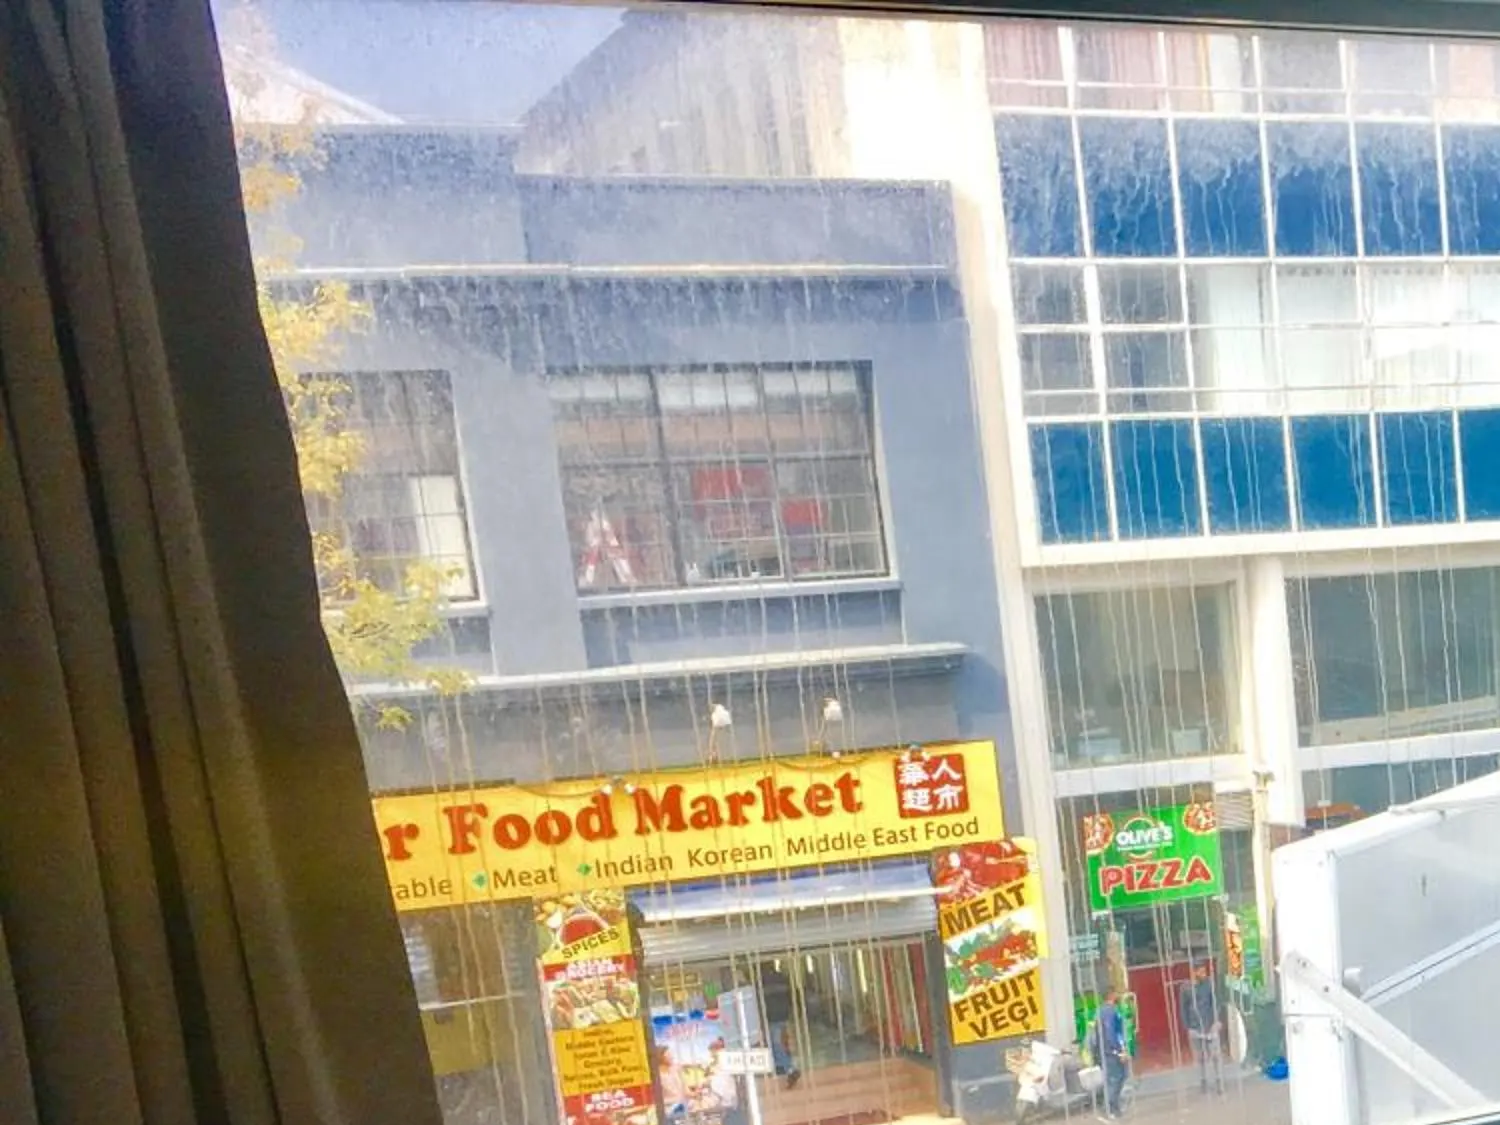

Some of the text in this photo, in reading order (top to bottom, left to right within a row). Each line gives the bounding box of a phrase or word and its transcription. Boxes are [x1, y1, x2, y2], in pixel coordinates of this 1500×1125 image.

[442, 789, 618, 855] Food
[632, 772, 864, 836] Market
[491, 864, 559, 890] Meat
[594, 853, 673, 879] Indian
[687, 843, 773, 868] Korean
[786, 830, 867, 857] Middle
[872, 825, 918, 847] East
[924, 816, 980, 841] Food
[1098, 856, 1214, 897] PIZZA
[943, 882, 1026, 937] MEAT
[560, 927, 621, 959] SPICES
[952, 970, 1036, 1022] FRUIT
[968, 995, 1039, 1039] VEGI
[583, 1097, 635, 1113] FOOD
